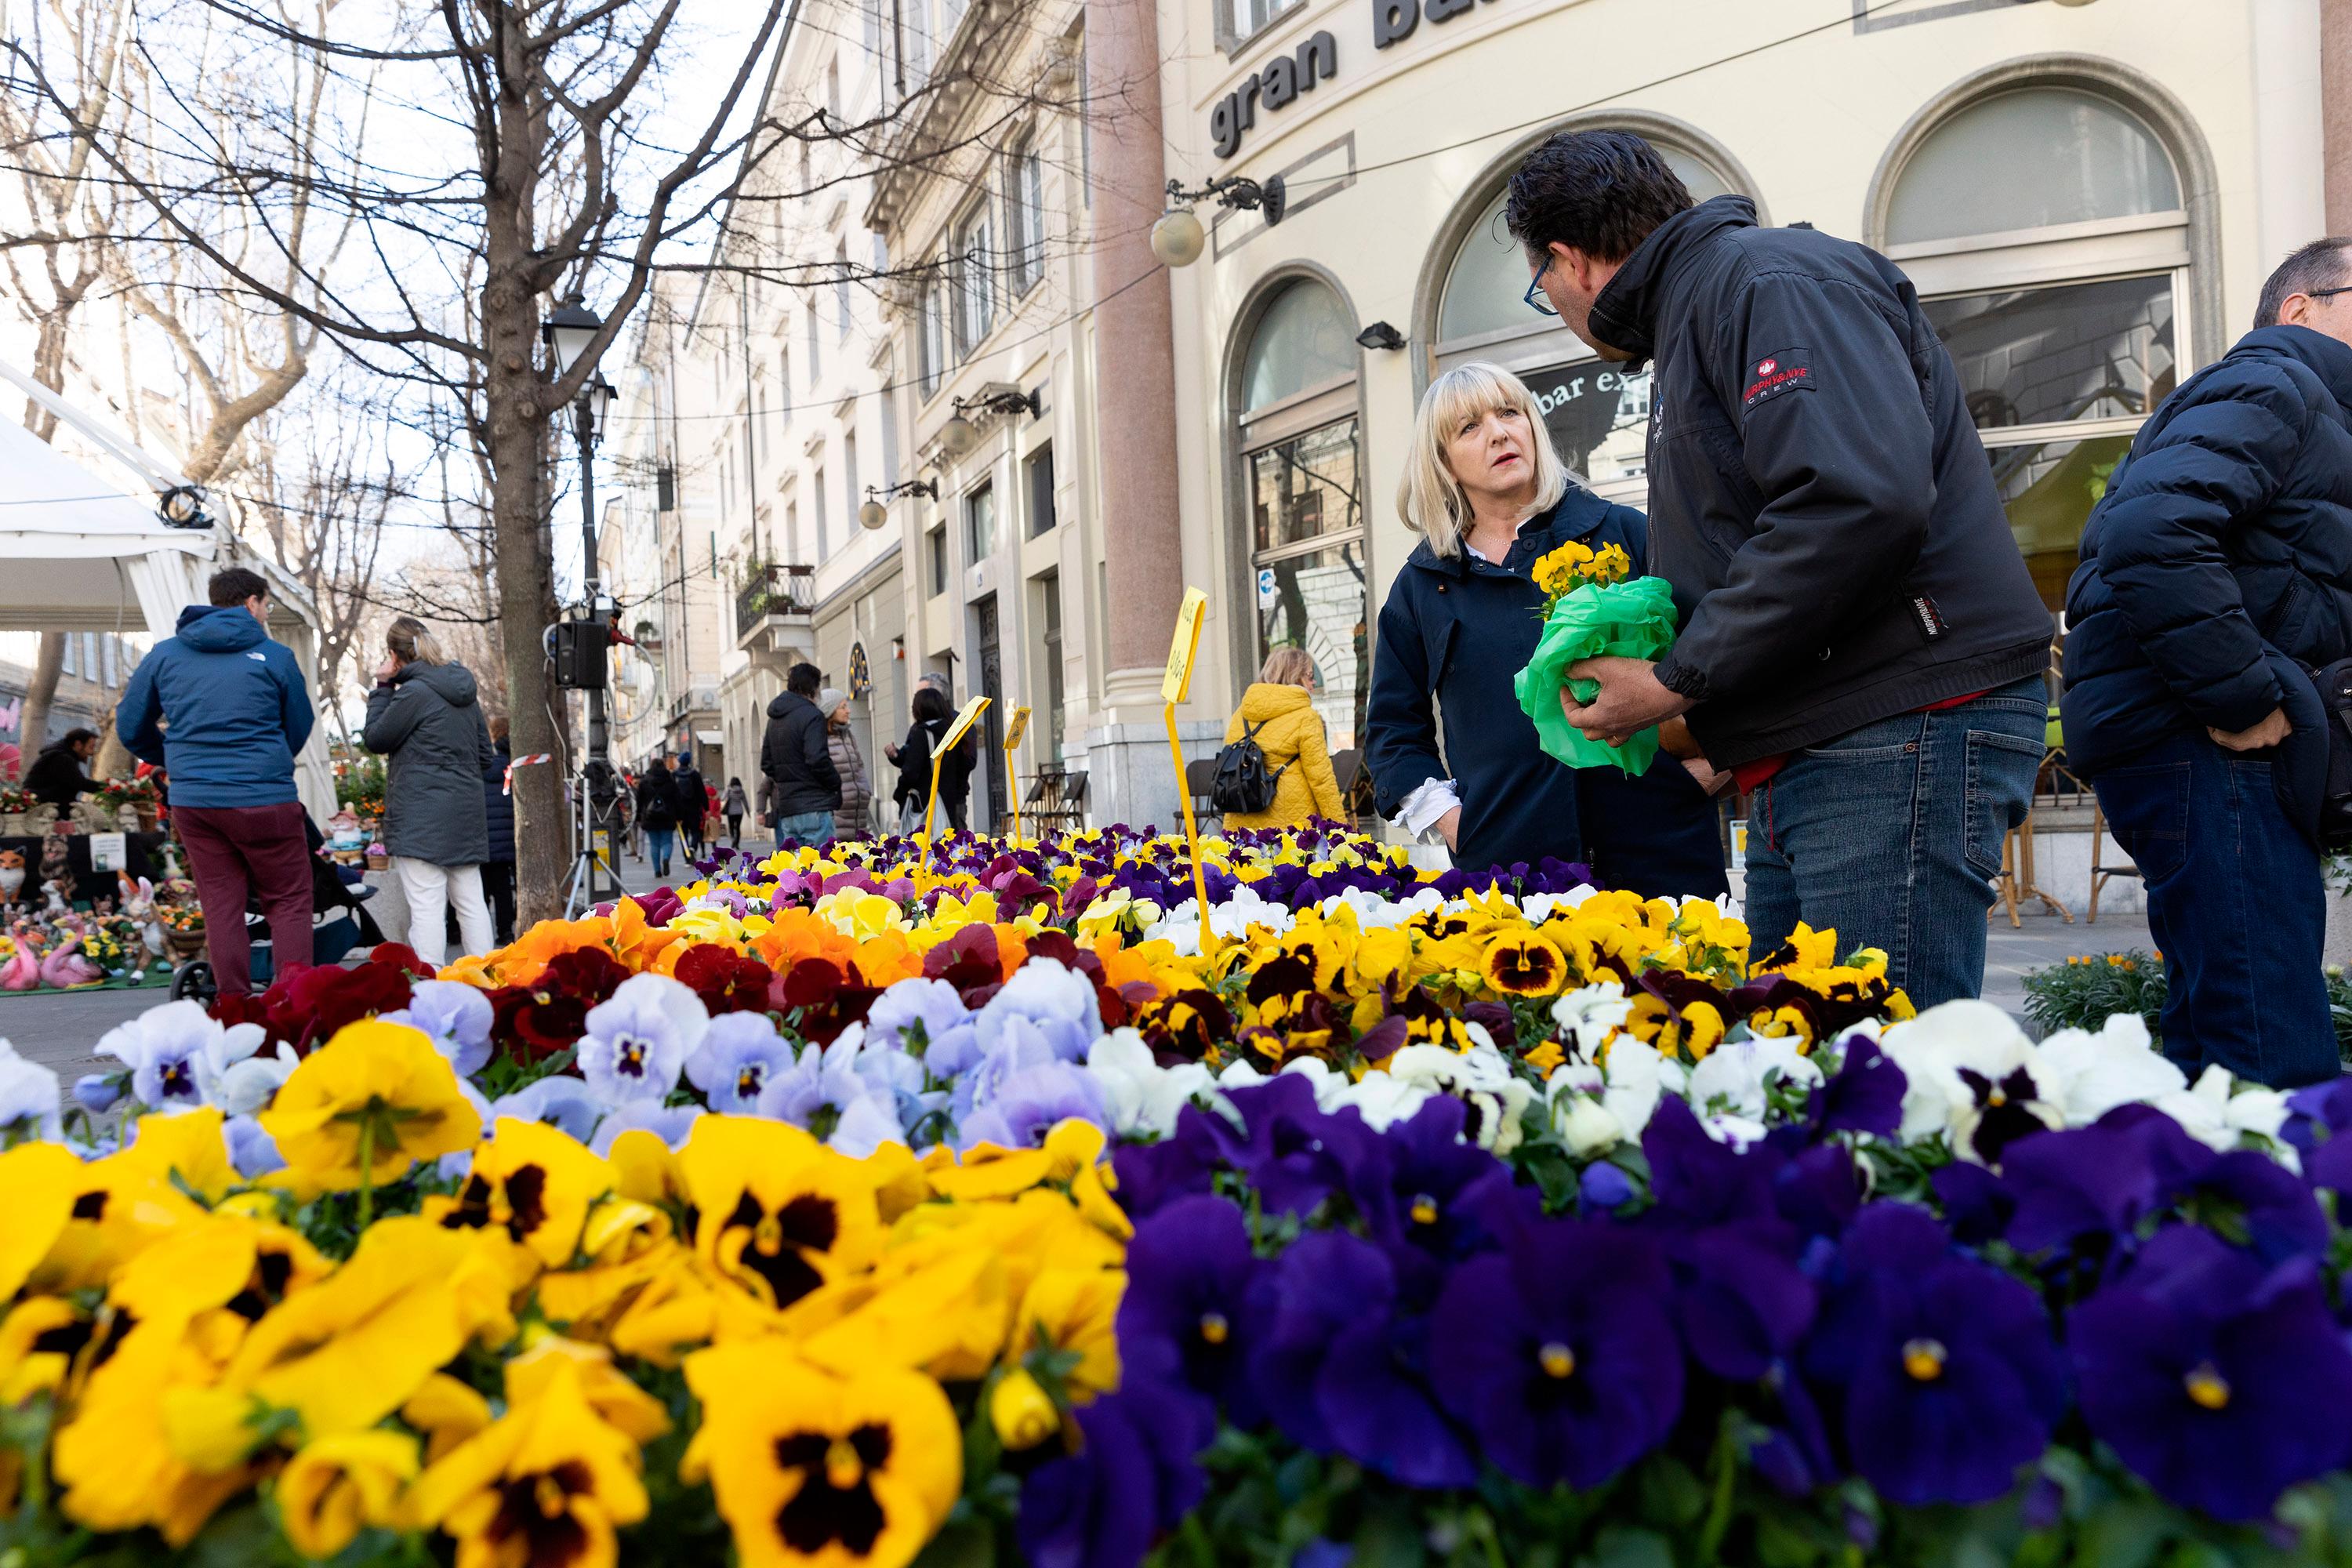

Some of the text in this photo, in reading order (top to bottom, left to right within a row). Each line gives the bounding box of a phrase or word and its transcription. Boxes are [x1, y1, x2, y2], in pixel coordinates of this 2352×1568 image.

[1210, 31, 1338, 159] gran
[1531, 376, 1585, 416] bar
[1748, 379, 1798, 404] CREW
